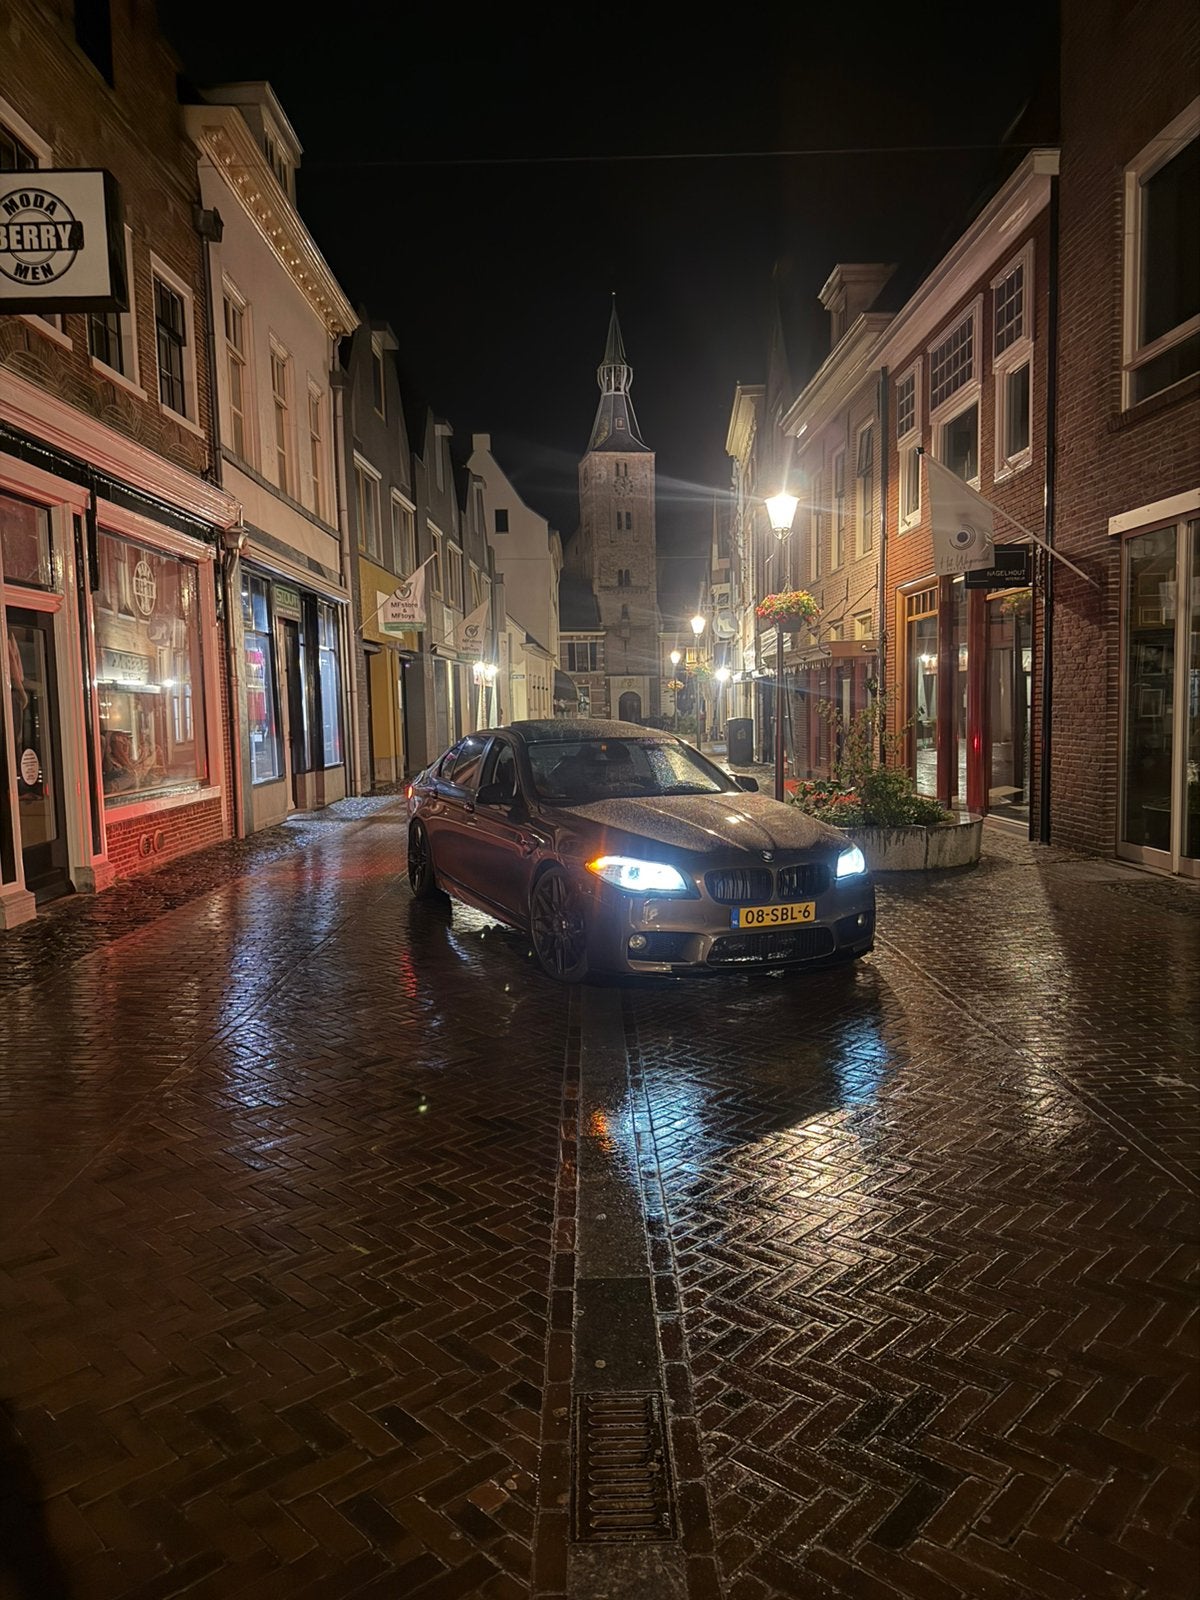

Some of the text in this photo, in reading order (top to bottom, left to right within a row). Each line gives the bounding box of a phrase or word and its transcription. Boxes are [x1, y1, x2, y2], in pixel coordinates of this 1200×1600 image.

[2, 193, 58, 216] MODA
[14, 263, 54, 280] MEN
[986, 569, 1026, 578] NAGELHOUT
[745, 905, 811, 925] 08-SBL-6
